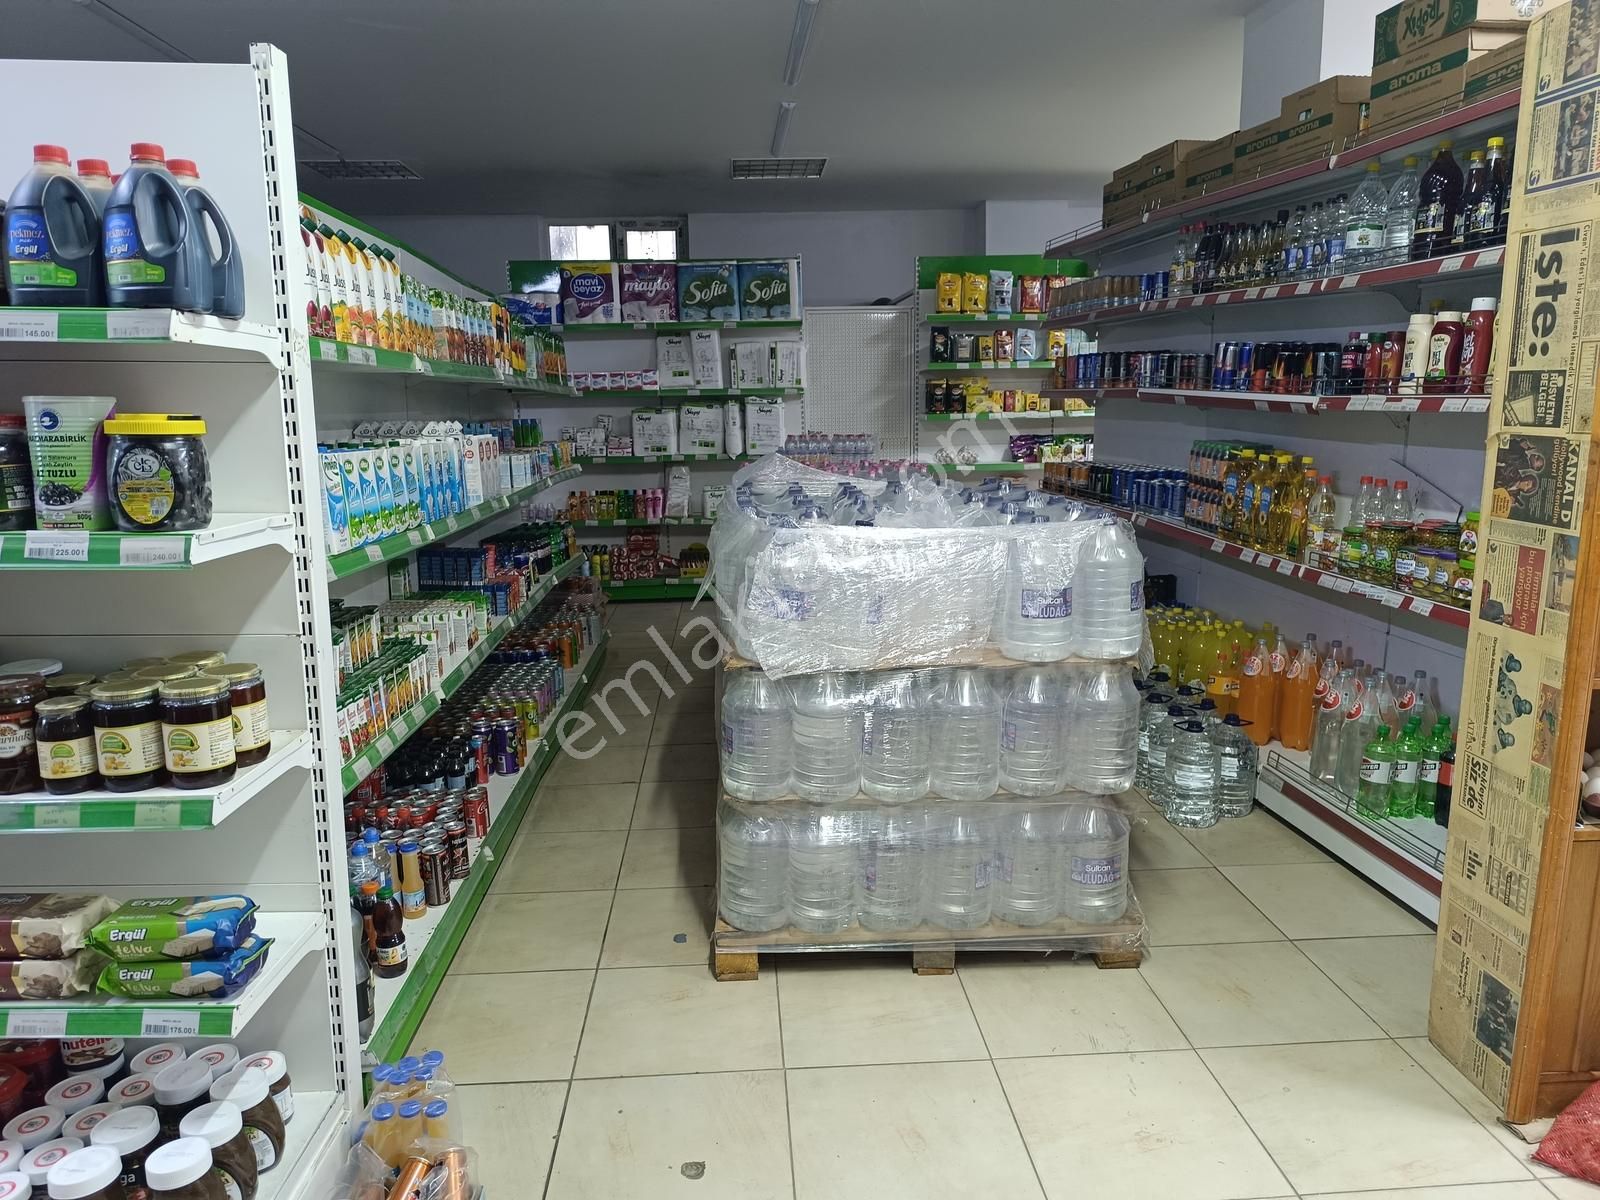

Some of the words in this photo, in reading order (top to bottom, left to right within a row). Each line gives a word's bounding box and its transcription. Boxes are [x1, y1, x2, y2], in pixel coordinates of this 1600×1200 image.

[1389, 62, 1442, 91] aroma
[1288, 119, 1320, 138] aroma
[1246, 134, 1279, 153] aroma
[15, 244, 38, 255] Ergül
[110, 244, 128, 254] Ergül
[573, 284, 603, 295] beyaz
[575, 276, 599, 286] mavi
[685, 280, 728, 305] Sofia
[745, 279, 788, 303] Sofia
[1557, 440, 1568, 487] Hollywood
[1562, 440, 1580, 503] KANAL
[47, 469, 77, 478] TUZLU
[1552, 489, 1562, 525] kendine
[1560, 510, 1572, 522] D
[55, 549, 81, 557] 225.00
[1528, 550, 1537, 564] bu
[1522, 565, 1533, 610] program
[1530, 571, 1542, 614] Firmalar
[1465, 719, 1476, 751] ATLAS
[1469, 757, 1481, 784] Siz
[1467, 786, 1479, 809] de
[1476, 762, 1489, 815] Bekleyin!
[1081, 872, 1115, 884] ULUDAĞ
[1085, 864, 1112, 873] Sultan
[109, 928, 147, 943] Ergül
[119, 969, 154, 982] Ergül
[170, 1026, 193, 1034] 175.00
